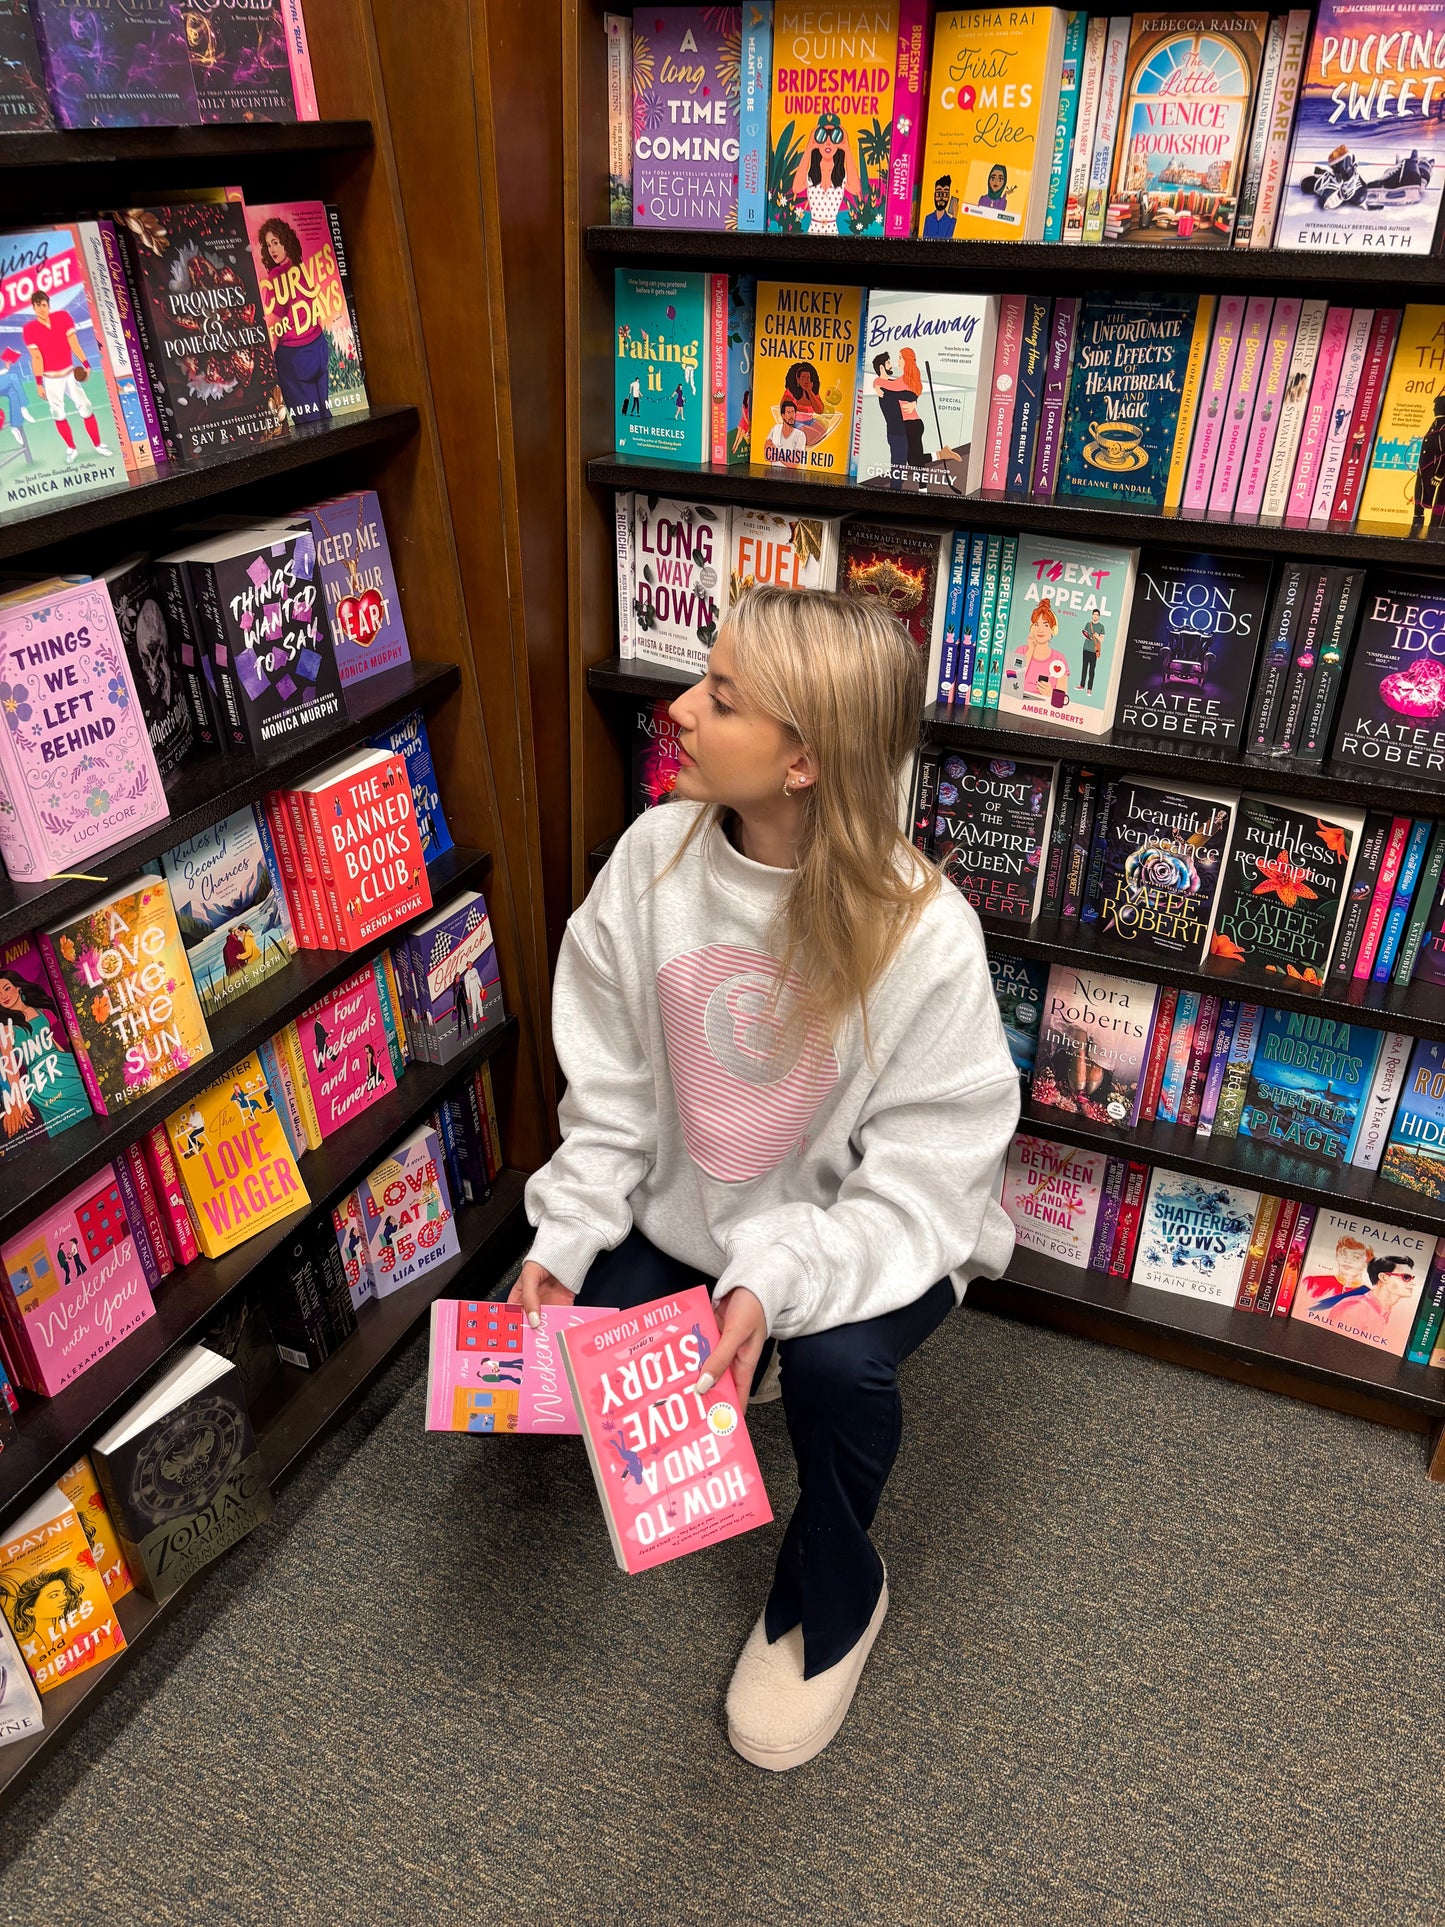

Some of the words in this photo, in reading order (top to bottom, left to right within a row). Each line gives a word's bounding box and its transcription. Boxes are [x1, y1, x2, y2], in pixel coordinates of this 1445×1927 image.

[783, 12, 890, 35] MEGHAN
[950, 15, 1003, 30] ALISHA
[1009, 12, 1035, 26] RAI
[1142, 18, 1206, 31] REBECCA
[1210, 18, 1259, 31] RAISIN
[680, 29, 698, 53] A
[792, 37, 877, 63] QUINN
[909, 25, 922, 93] BRIDESMAID
[1283, 31, 1305, 71] THE
[660, 56, 705, 94] long
[778, 68, 889, 94] BRIDESMAID
[667, 100, 726, 125] TIME
[784, 96, 879, 114] UNDERCOVER
[941, 84, 1032, 113] COMES
[1145, 102, 1228, 128] VENICE
[1272, 79, 1294, 141] SPARE
[1329, 76, 1445, 124] SWEET
[635, 137, 740, 162] COMING
[1133, 135, 1230, 155] BOOKSHOP
[641, 177, 732, 198] MEGHAN
[1267, 159, 1279, 182] AVA
[650, 199, 720, 220] QUINN
[1262, 186, 1274, 215] RANI
[329, 213, 347, 276] DECEPTION
[1298, 231, 1353, 245] EMILY
[1363, 233, 1412, 247] RATH
[6, 279, 36, 306] TO
[37, 261, 71, 292] GET
[259, 244, 335, 315] CURVES
[169, 287, 245, 315] PROMISES
[269, 320, 291, 343] FOR
[293, 282, 343, 335] DAYS
[778, 289, 843, 315] MICKEY
[164, 326, 265, 357] POMEGRANATES
[765, 314, 852, 340] CHAMBERS
[869, 313, 980, 347] Breakaway
[1092, 319, 1182, 342] UNFORTUNATE
[618, 333, 699, 370] Faking
[760, 338, 815, 361] SHAKES
[819, 342, 833, 362] IT
[836, 344, 855, 363] UP
[1081, 344, 1113, 369] SIDE
[1115, 343, 1173, 364] EFFECTS
[647, 365, 663, 391] it
[1085, 372, 1175, 395] HEARTBREAK
[1406, 380, 1432, 393] and
[995, 408, 1004, 436] GRACE
[1104, 396, 1149, 421] MAGIC
[1305, 406, 1323, 446] ERICA
[630, 425, 649, 435] BETH
[651, 427, 685, 439] REEKLES
[766, 447, 808, 465] CHARISH
[811, 451, 834, 467] REID
[992, 440, 1001, 469] REILLY
[7, 477, 61, 502] MONICA
[63, 466, 116, 489] MURPHY
[867, 466, 908, 480] GRACE
[912, 471, 957, 486] REILLY
[1295, 452, 1312, 500] RIDLEY
[316, 537, 352, 567] KEEP
[357, 522, 380, 552] ME
[617, 513, 627, 560] RICOCHET
[642, 518, 713, 563] LONG
[656, 558, 694, 588] WAY
[638, 582, 713, 628] DOWN
[1024, 583, 1111, 616] APPEAL
[1141, 573, 1236, 610] NEON
[244, 586, 316, 650] WANTED
[331, 599, 391, 646] HEART
[1168, 606, 1252, 636] GODS
[10, 626, 91, 670] THINGS
[44, 665, 79, 695] WE
[44, 690, 94, 729] LEFT
[261, 714, 299, 740] MONICA
[300, 698, 339, 725] MURPHY
[1022, 704, 1047, 717] AMBER
[1050, 709, 1084, 724] ROBERTS
[1134, 690, 1221, 717] KATEE
[40, 716, 116, 763] BEHIND
[1122, 709, 1235, 738] ROBERT
[349, 776, 381, 808] THE
[962, 775, 1033, 803] COURT
[73, 822, 99, 844] LUCY
[102, 804, 136, 830] SCORE
[331, 792, 410, 852] BANNED
[1128, 791, 1216, 837] beautiful
[345, 825, 411, 879] BOOKS
[945, 818, 1036, 854] VAMPIRE
[1115, 823, 1220, 867] vengeance
[1363, 839, 1371, 859] RUIN
[1368, 829, 1385, 871] MIDNIGHT
[359, 859, 409, 903] CLUB
[360, 917, 393, 938] BRENDA
[394, 897, 422, 922] NOVAK
[1114, 880, 1201, 922] KATEE
[1234, 898, 1318, 939] KATEE
[108, 911, 129, 940] A
[1101, 899, 1208, 945] ROBERT
[1220, 914, 1325, 960] ROBERT
[434, 928, 488, 993] Offtrack
[302, 1000, 330, 1019] ELLIE
[332, 971, 371, 999] PALMER
[1065, 973, 1131, 1007] Nora
[334, 994, 363, 1024] Four
[1051, 998, 1143, 1038] Roberts
[312, 1007, 377, 1070] Weekends
[1046, 1028, 1137, 1065] Inheritance
[1287, 1012, 1350, 1049] NORA
[124, 1024, 182, 1074] SUN
[1264, 1034, 1363, 1084] ROBERTS
[1224, 1067, 1242, 1116] LEGACY
[1258, 1084, 1346, 1125] SHELTER
[1250, 1111, 1341, 1158] PLACE
[1375, 1106, 1387, 1130] YEAR
[203, 1123, 271, 1190] LOVE
[1366, 1131, 1379, 1150] ONE
[1021, 1149, 1093, 1184] BETWEEN
[1028, 1170, 1081, 1199] DESIRE
[202, 1157, 299, 1236] WAGER
[366, 1159, 440, 1217] LOVE
[176, 1219, 186, 1246] PAINTER
[182, 1219, 191, 1234] LYNN
[1024, 1201, 1075, 1231] DENIAL
[1329, 1215, 1357, 1233] THE
[1361, 1225, 1425, 1251] PALACE
[1162, 1221, 1227, 1254] VOWS
[393, 1262, 415, 1283] LISA
[418, 1244, 446, 1268] PEERS
[34, 1243, 132, 1349] Weekends
[1146, 1273, 1185, 1290] SHAIN
[1192, 1285, 1222, 1297] ROSE
[642, 1302, 681, 1328] YULIN
[1308, 1312, 1334, 1326] PAUL
[1337, 1322, 1388, 1345] RUDNICK
[59, 1336, 117, 1384] ALEXANDRA
[120, 1310, 147, 1334] PAIGE
[595, 1320, 639, 1350] KUANG
[600, 1335, 702, 1414] STORY
[623, 1385, 707, 1453] LOVE
[683, 1466, 748, 1525] HOW
[8, 1515, 75, 1558] PAYNE
[149, 1476, 258, 1576] ZODIAC
[635, 1502, 676, 1545] TO
[48, 1600, 94, 1640] LIES
[38, 1639, 66, 1662] and
